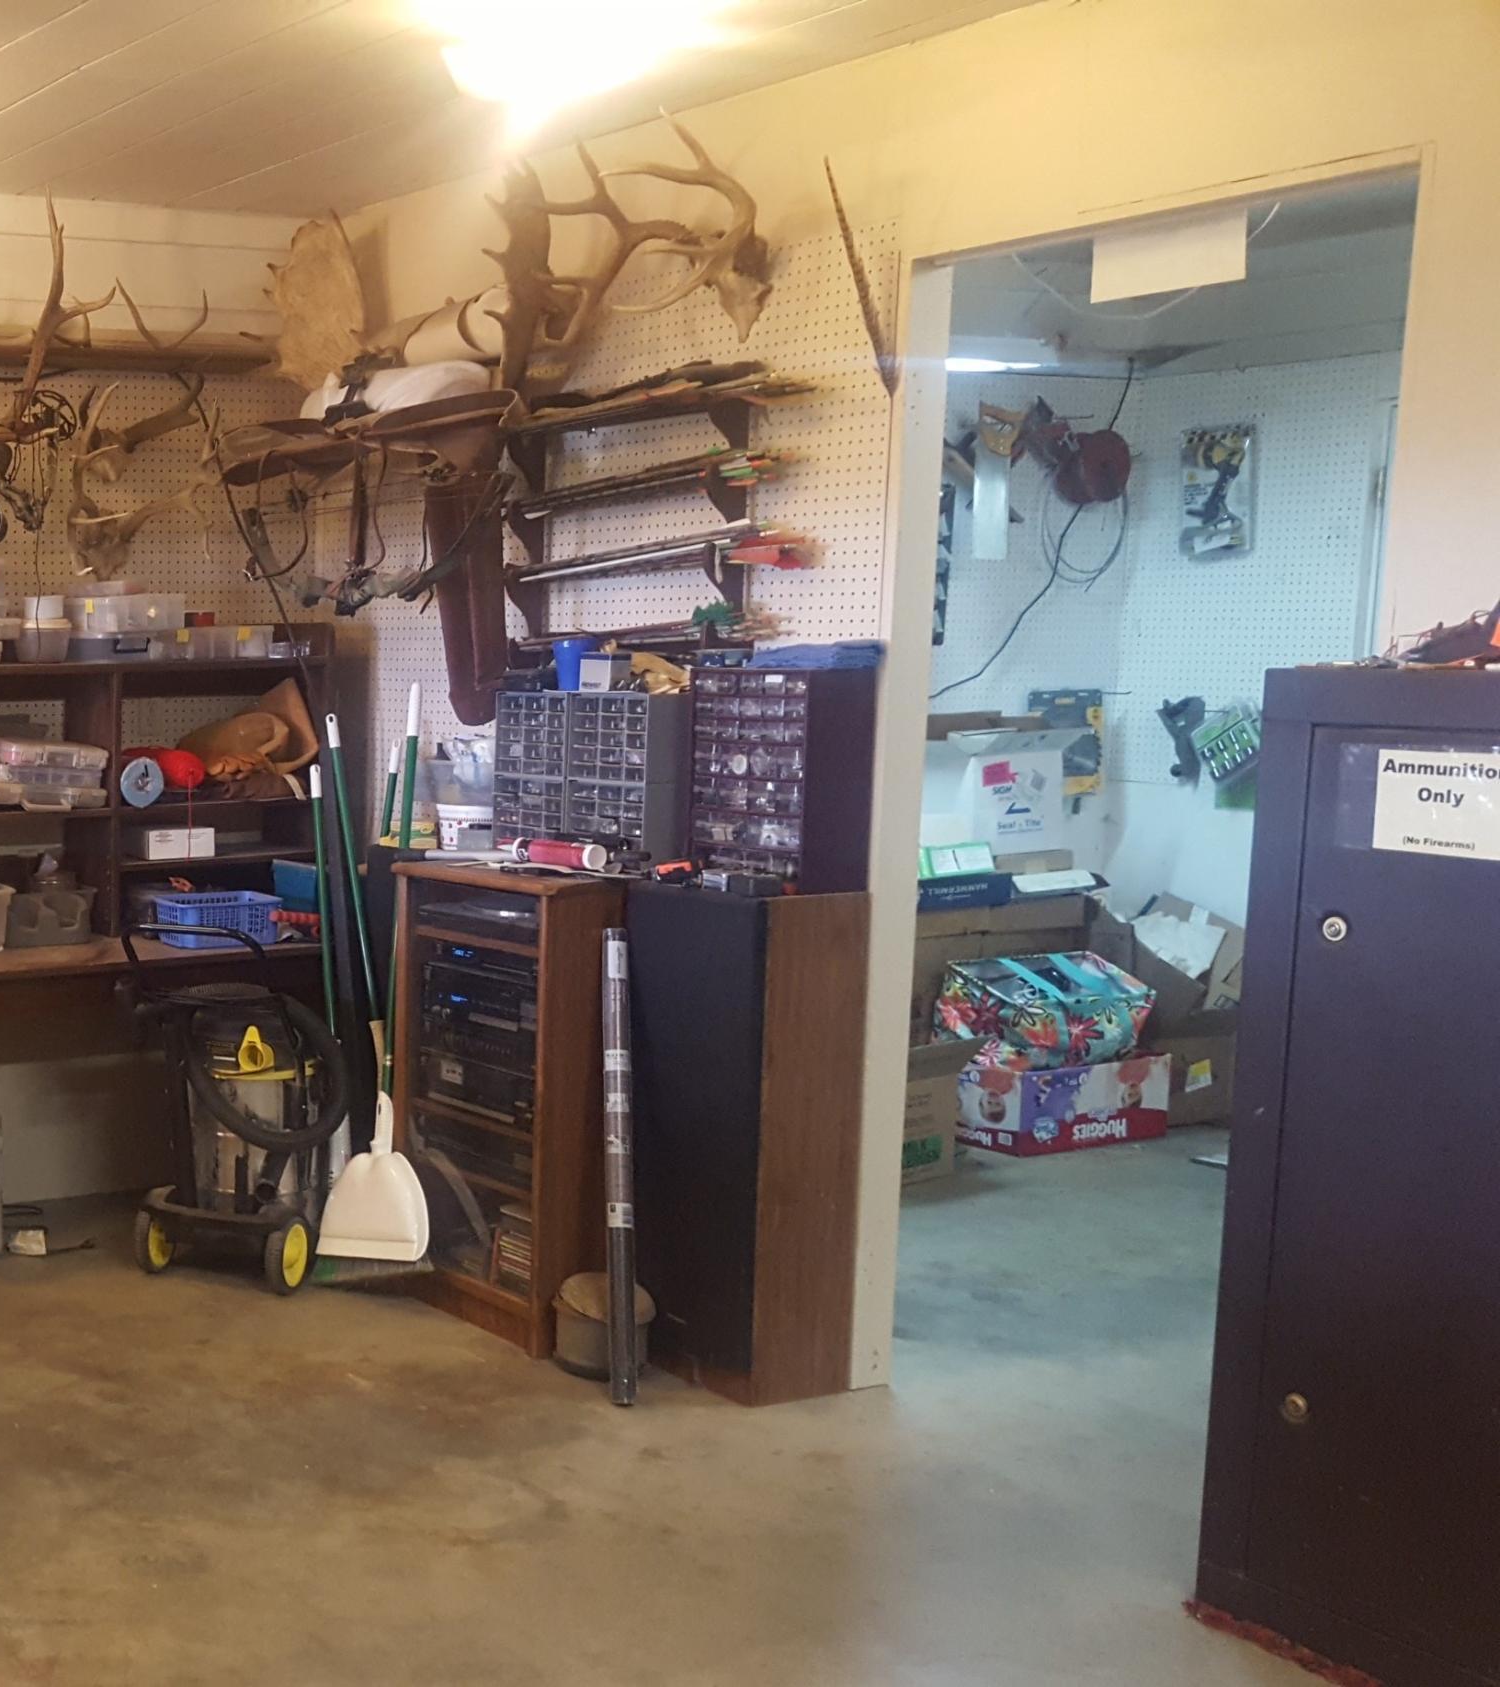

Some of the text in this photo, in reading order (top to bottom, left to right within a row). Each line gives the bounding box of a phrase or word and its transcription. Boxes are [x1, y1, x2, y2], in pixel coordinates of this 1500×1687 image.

[1383, 758, 1500, 780] Ammunitio
[1417, 787, 1465, 808] Only
[1402, 835, 1476, 851] (No Firearms)
[1073, 1118, 1127, 1140] HUGGIES
